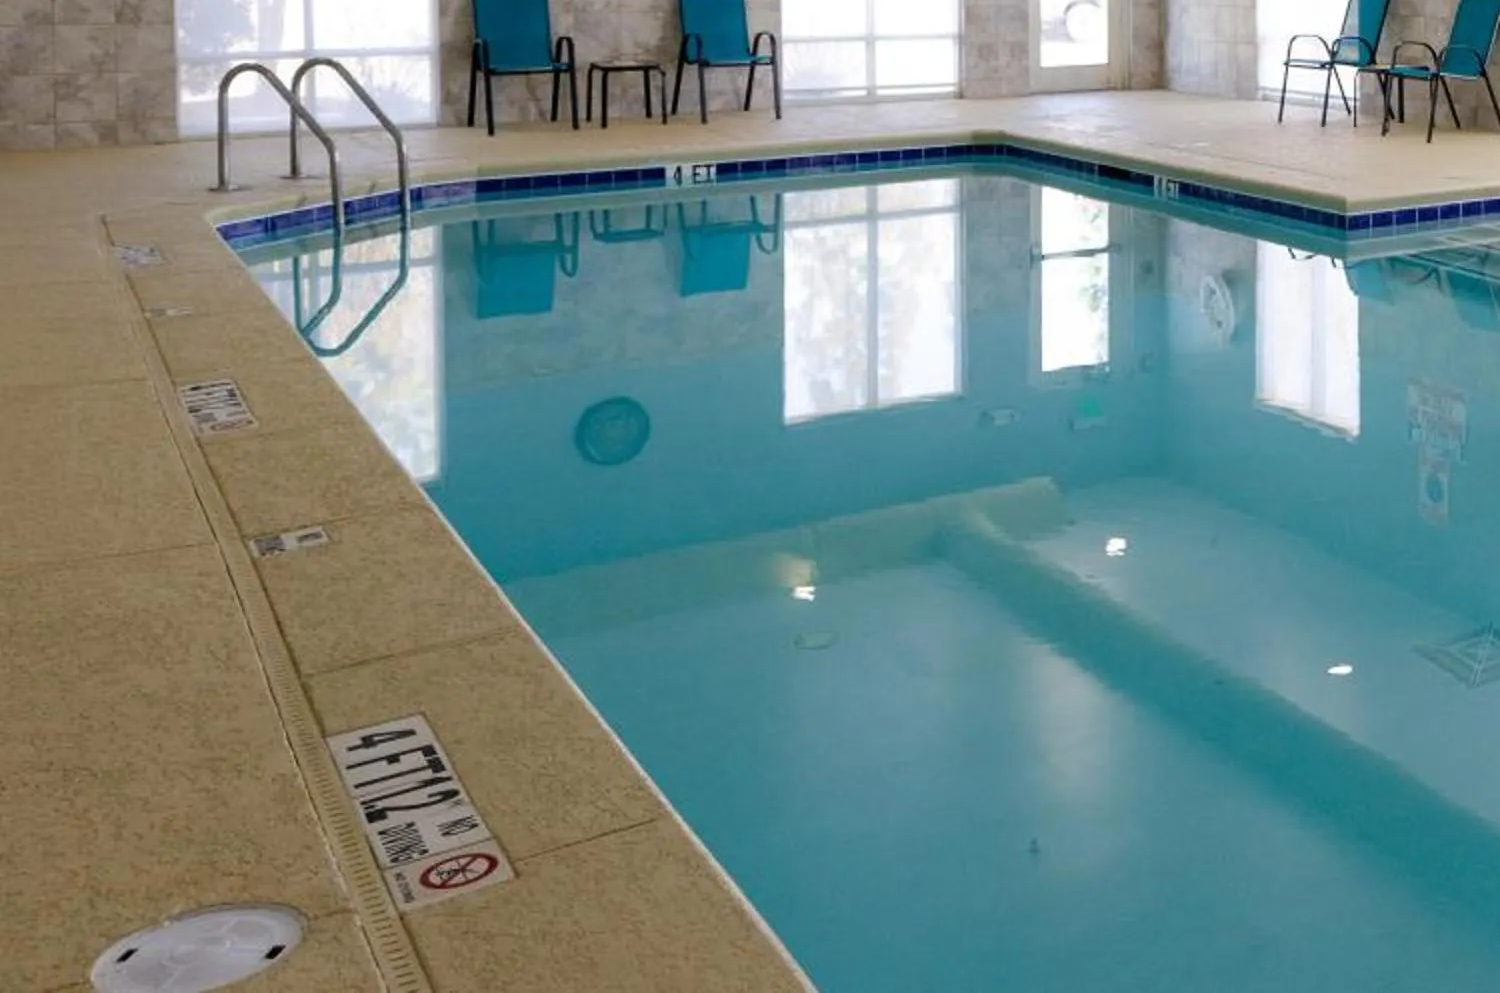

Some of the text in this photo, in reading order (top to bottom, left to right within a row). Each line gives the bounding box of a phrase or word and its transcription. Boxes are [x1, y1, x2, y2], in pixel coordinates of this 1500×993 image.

[346, 728, 417, 751] 4
[345, 743, 447, 790] FT
[438, 813, 480, 837] NO
